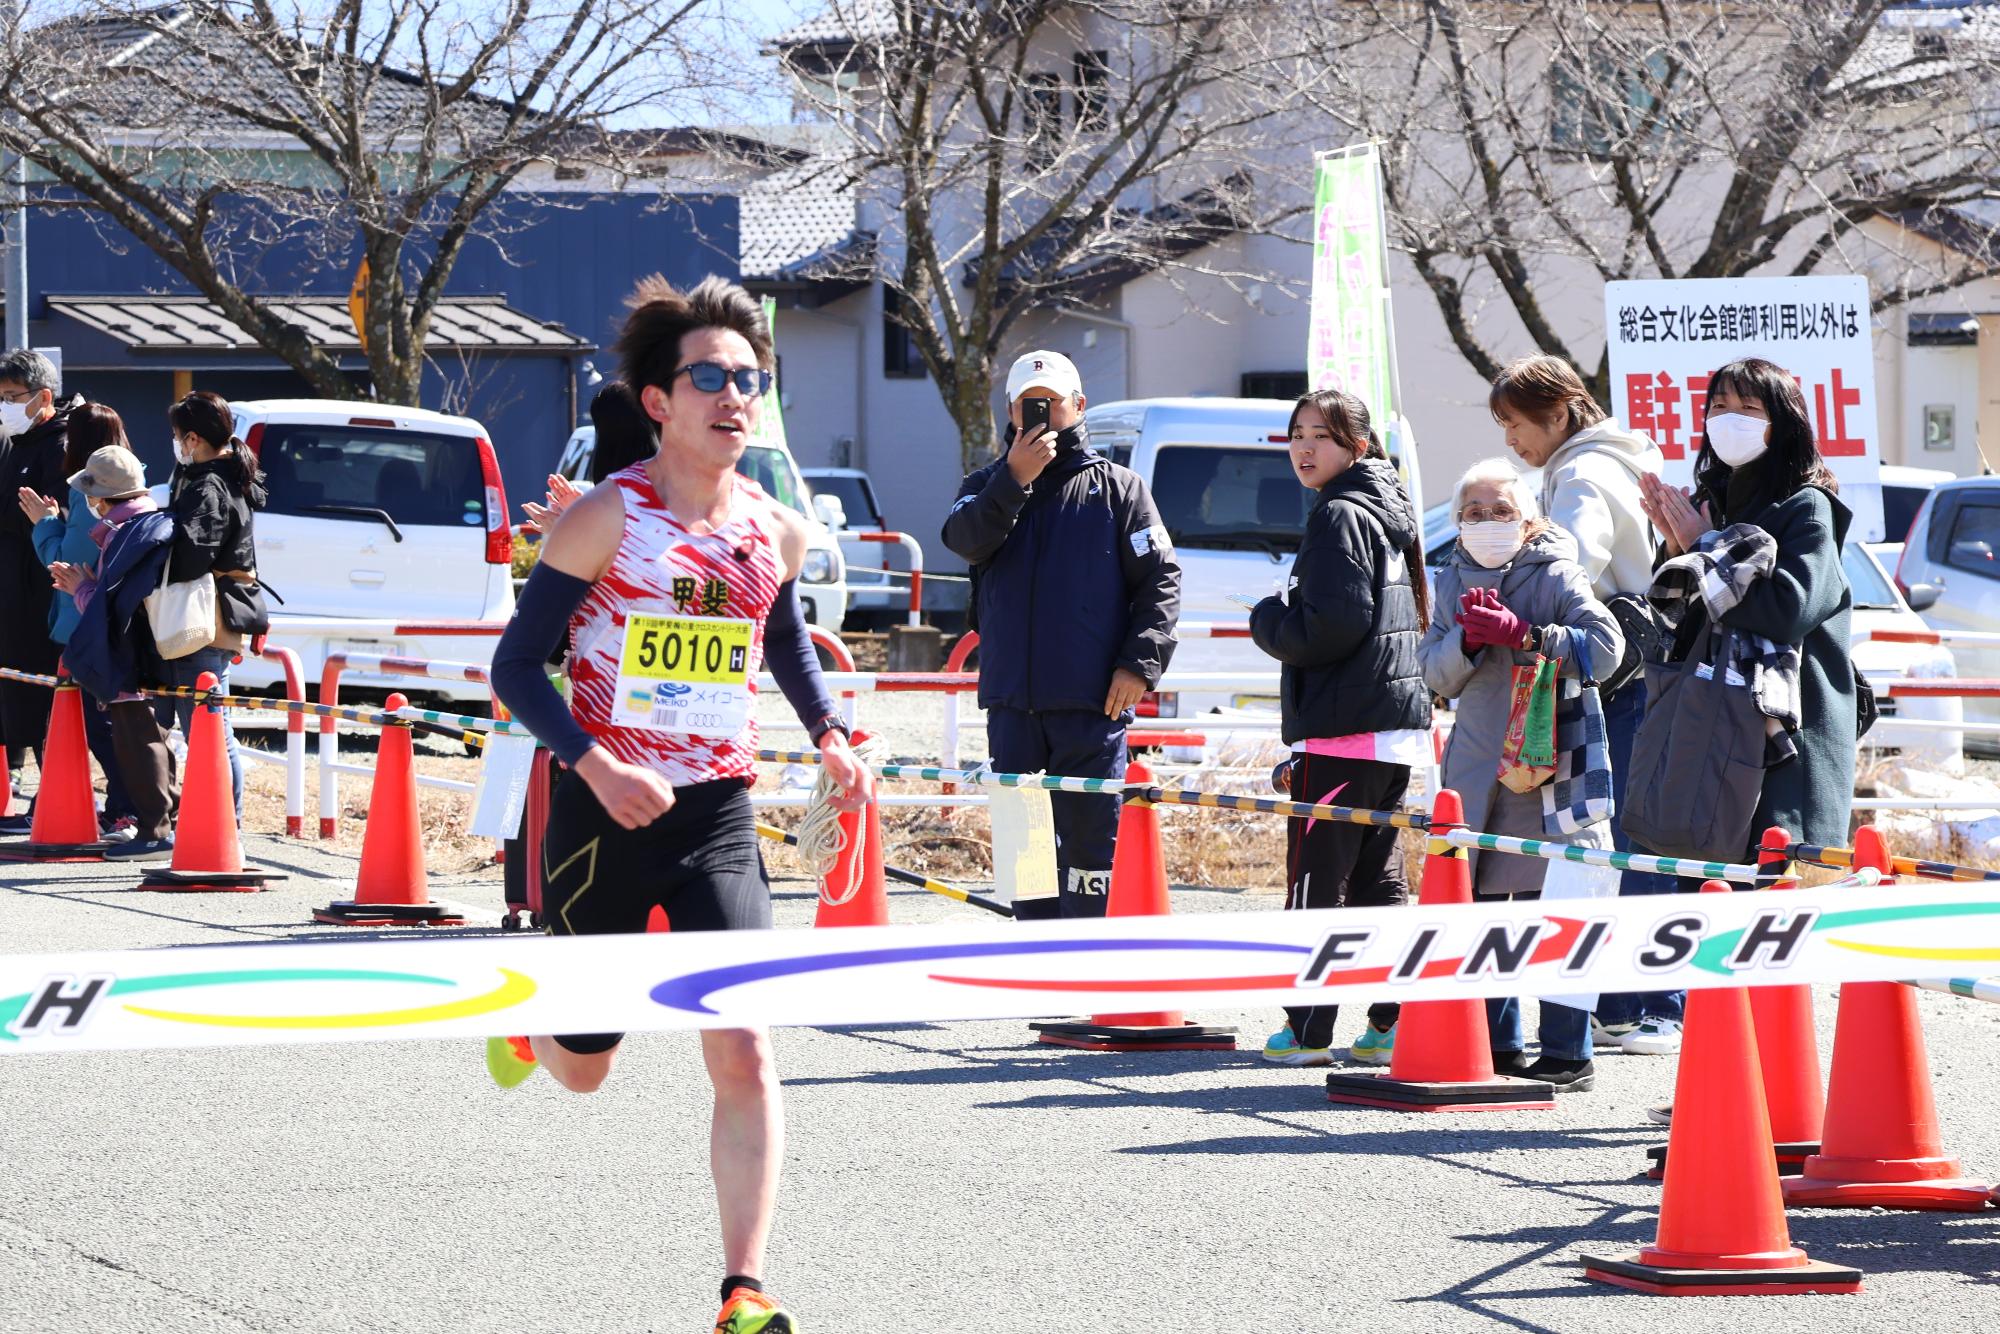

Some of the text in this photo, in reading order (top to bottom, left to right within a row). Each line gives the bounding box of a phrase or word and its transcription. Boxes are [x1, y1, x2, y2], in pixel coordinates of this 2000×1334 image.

[1619, 302, 1859, 343] 総合文化会館御利用以外は
[1032, 360, 1043, 371] B
[1626, 368, 1866, 460] 駐止
[672, 577, 729, 616] 甲斐
[638, 630, 744, 673] 5010 H
[654, 697, 688, 708] MEIKO
[694, 690, 743, 704] メイコー
[1302, 911, 1819, 983] FINISH
